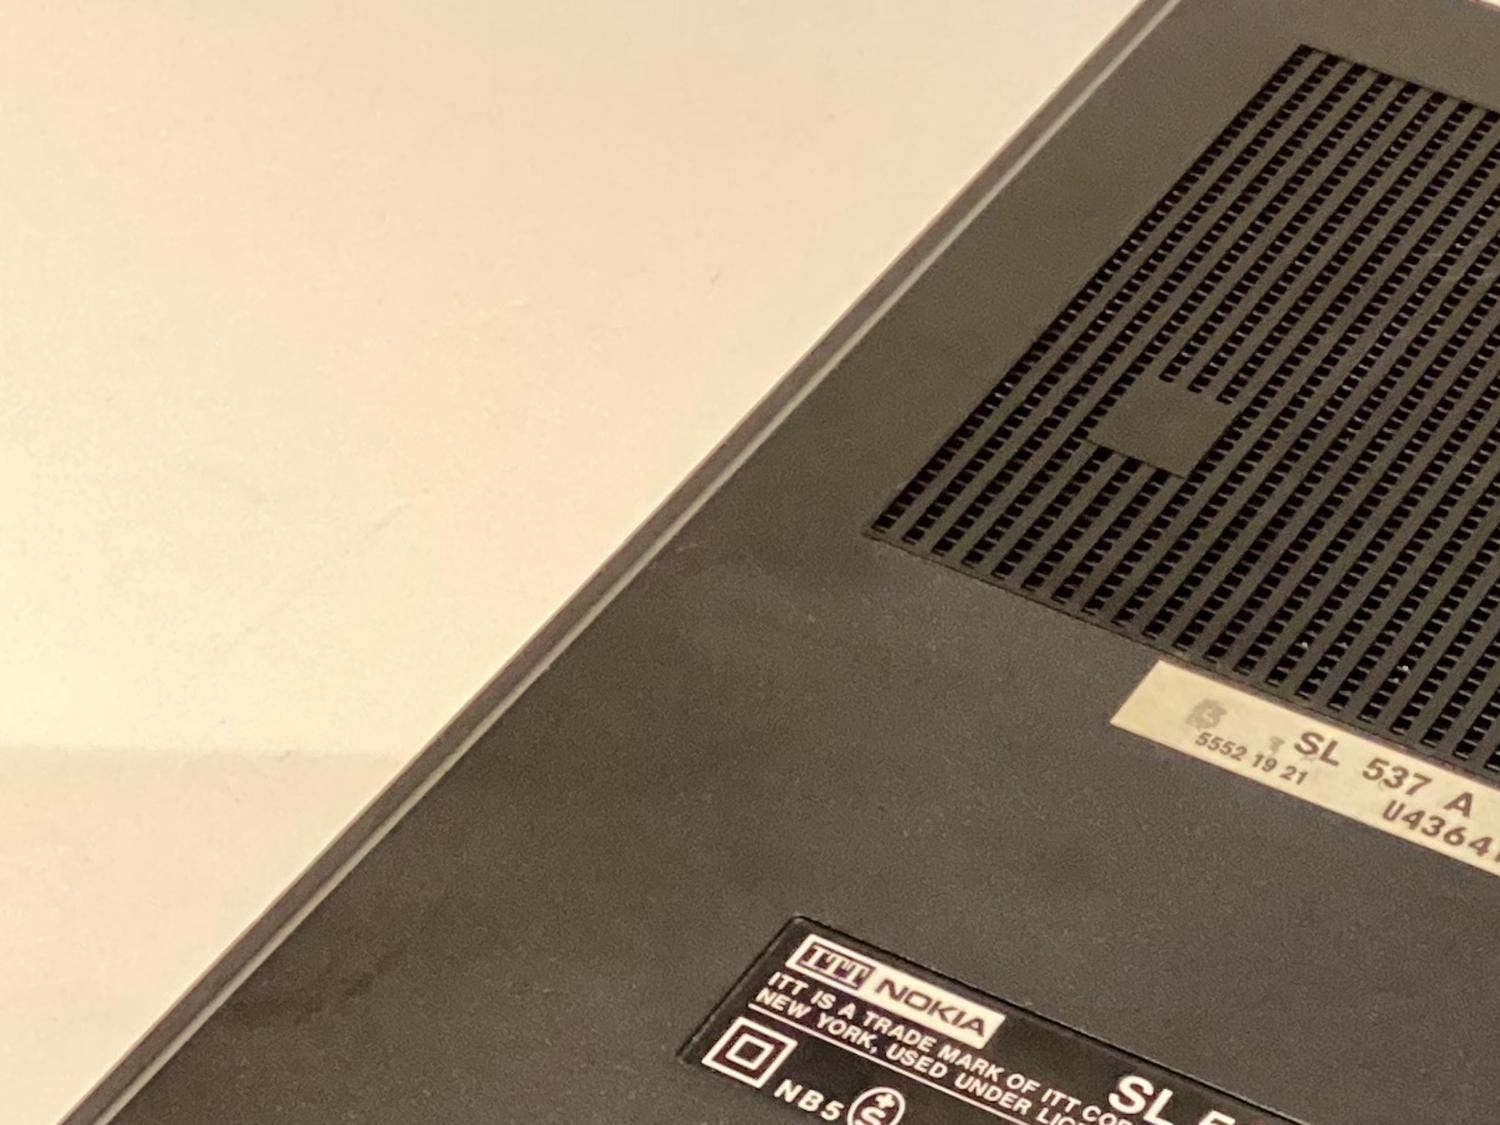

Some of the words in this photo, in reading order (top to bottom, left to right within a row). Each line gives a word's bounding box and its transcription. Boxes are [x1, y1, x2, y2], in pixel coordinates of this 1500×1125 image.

[1195, 732, 1248, 761] 5552
[1252, 752, 1278, 772] 19
[1280, 765, 1308, 785] 21
[1294, 731, 1340, 767] SL
[1362, 757, 1432, 796] 537
[1443, 792, 1474, 818] A
[798, 943, 870, 989] ITT
[875, 978, 985, 1038] NOKIA
[755, 987, 812, 1019] NEW
[816, 1012, 878, 1054] YORK,
[886, 1043, 948, 1079] USED
[954, 1072, 1032, 1116] UNDER
[767, 971, 809, 996] ITT
[811, 990, 837, 1009] IS
[838, 1002, 856, 1020] A
[863, 1011, 937, 1051] TRADE
[937, 1045, 1005, 1082] MARK
[1005, 1073, 1041, 1094] OF
[1041, 1088, 1082, 1113] ITT
[773, 1078, 845, 1122] NB5
